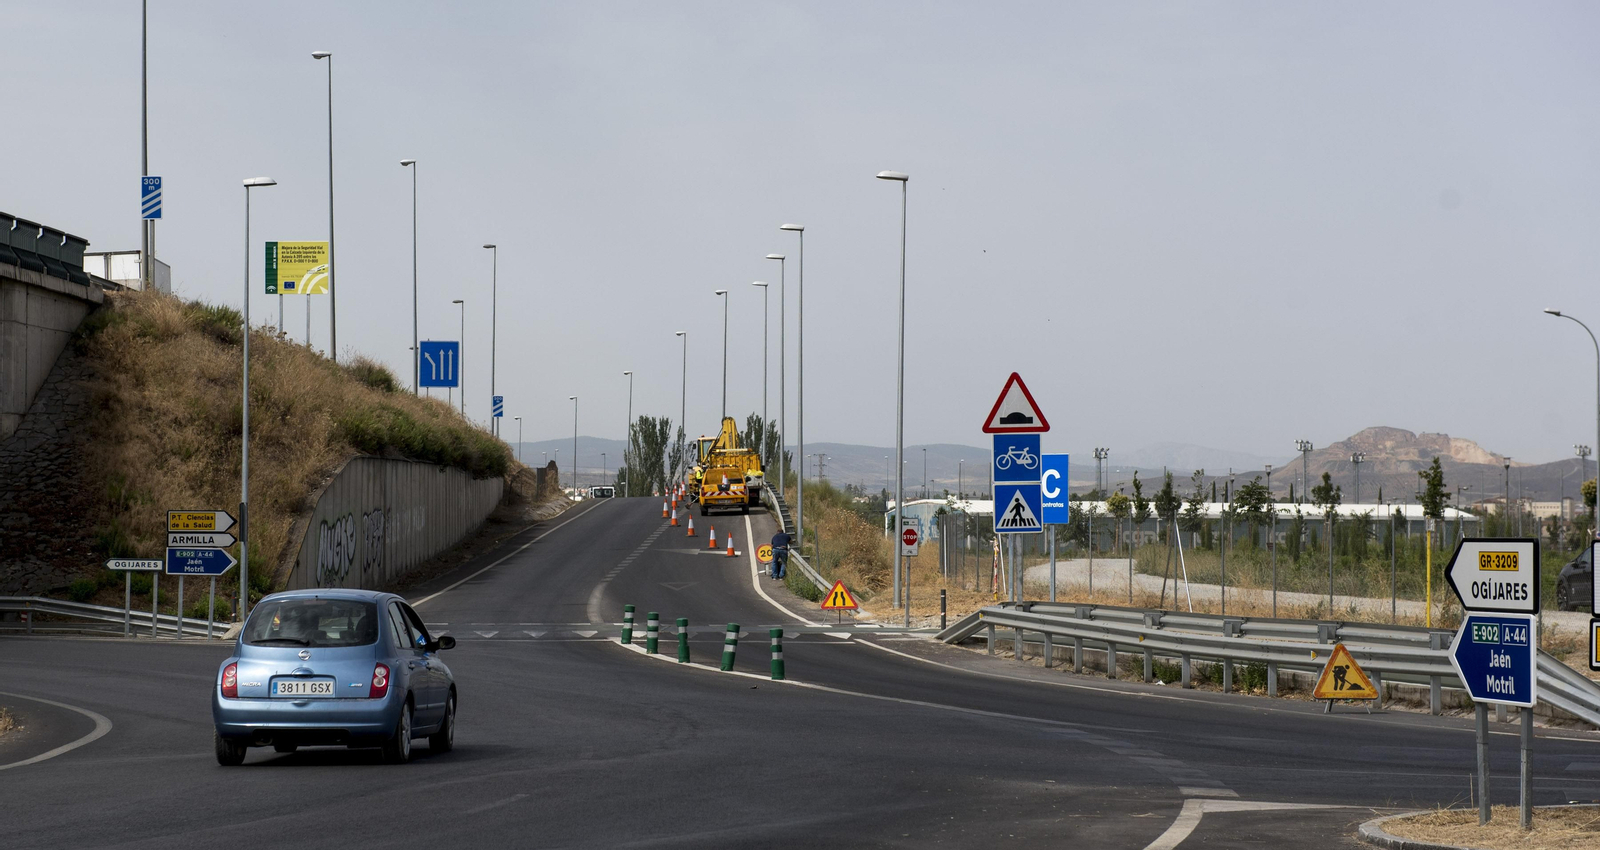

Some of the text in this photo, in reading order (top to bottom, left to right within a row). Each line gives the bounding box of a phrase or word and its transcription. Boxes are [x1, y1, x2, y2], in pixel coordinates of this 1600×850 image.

[1480, 554, 1518, 568] GR-3209
[1471, 578, 1528, 600] OGÍJARES
[1473, 625, 1526, 643] E-902 A-44
[1489, 650, 1511, 668] Jaén
[280, 683, 331, 693] 3811 GSX
[1486, 675, 1515, 694] Motril
